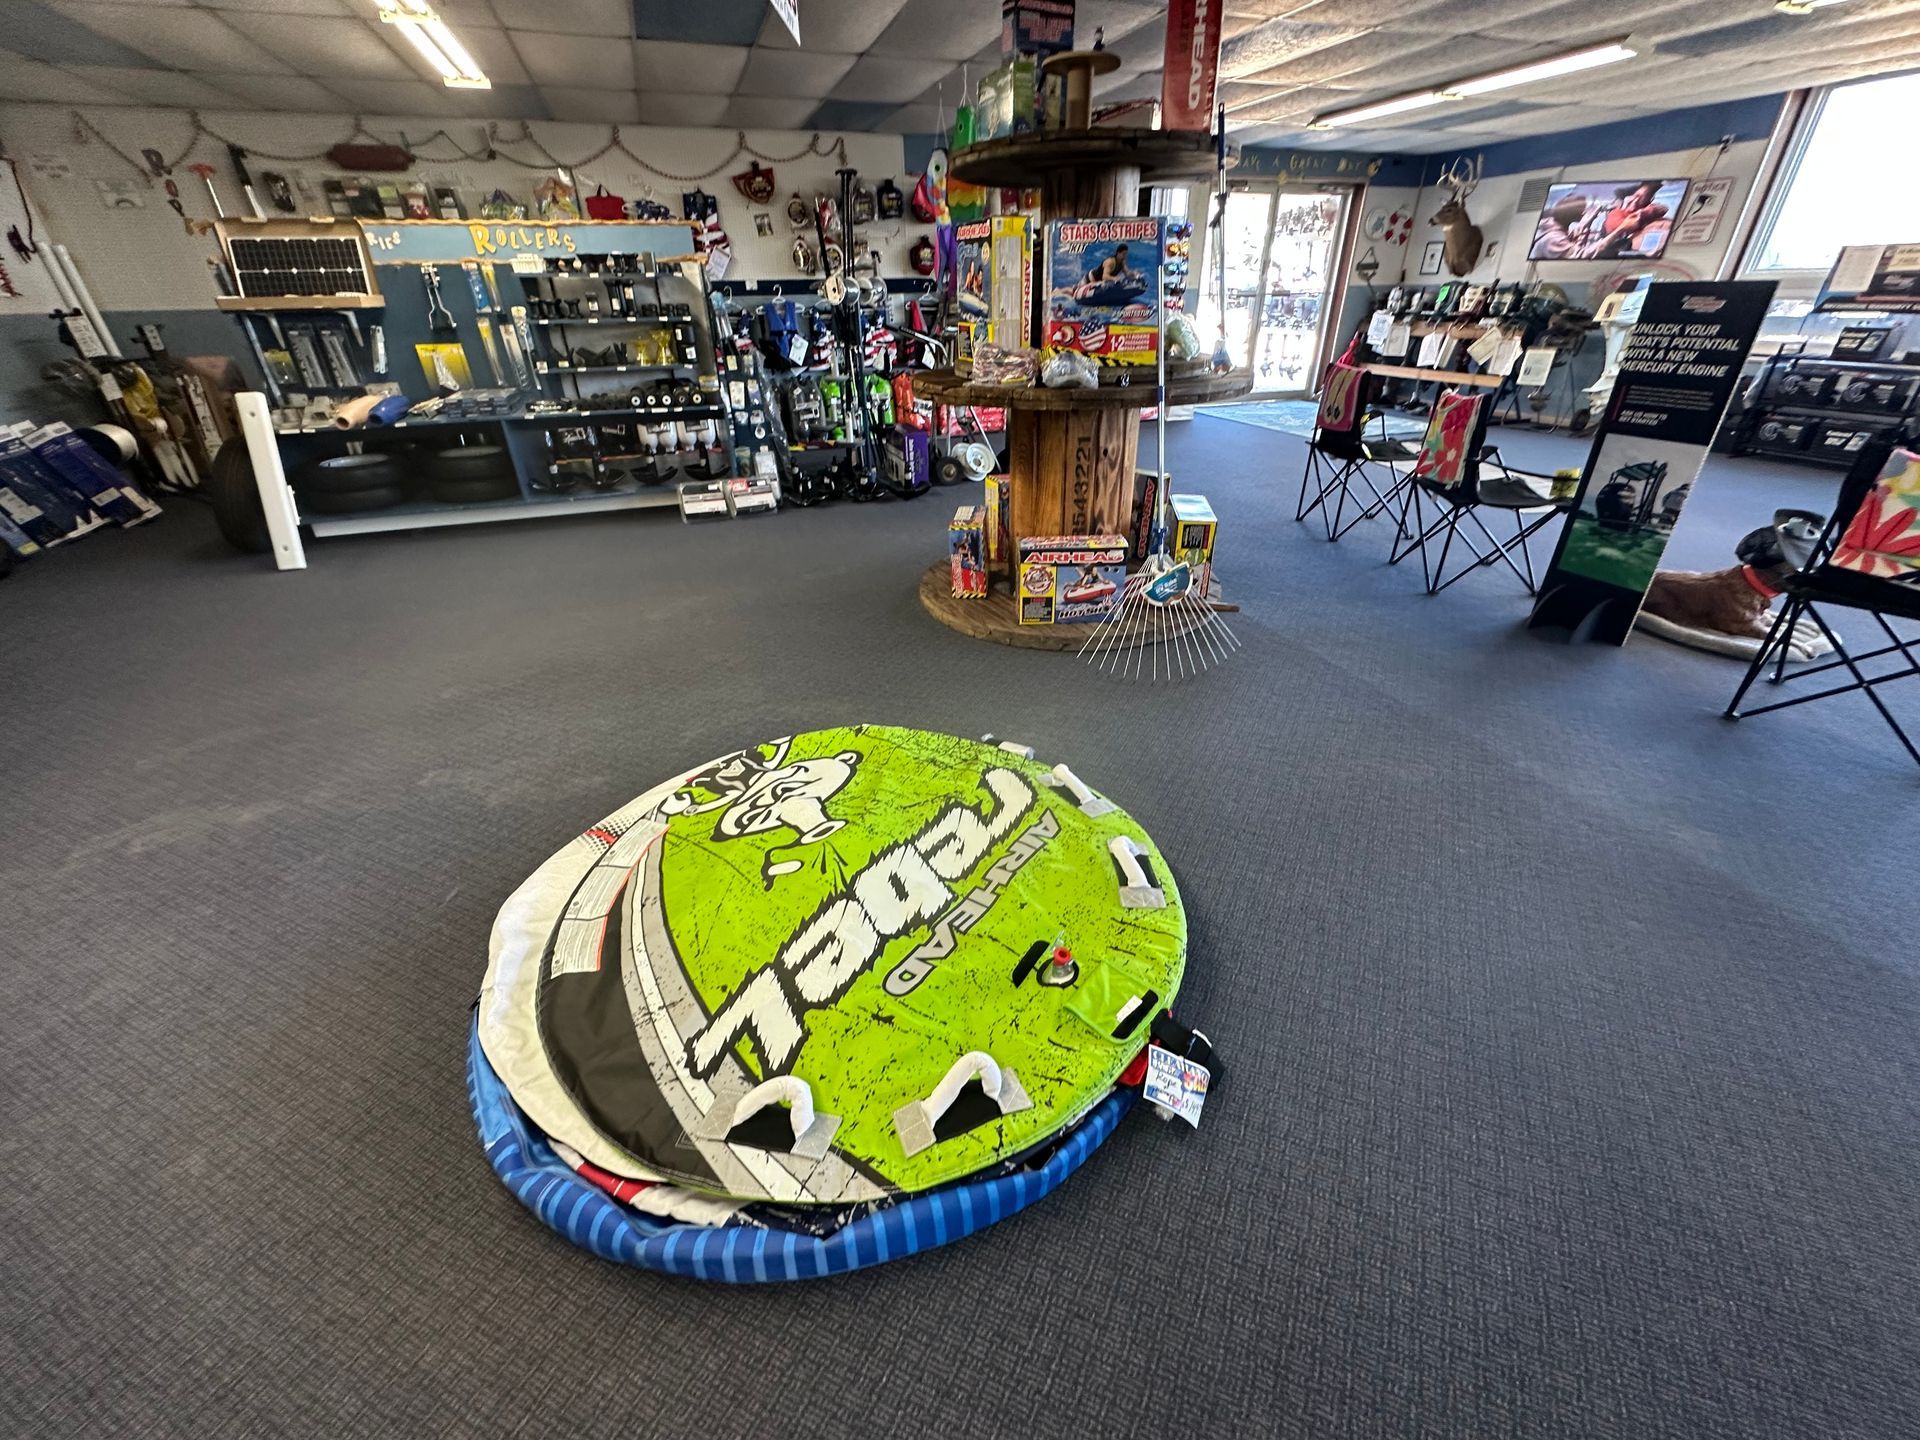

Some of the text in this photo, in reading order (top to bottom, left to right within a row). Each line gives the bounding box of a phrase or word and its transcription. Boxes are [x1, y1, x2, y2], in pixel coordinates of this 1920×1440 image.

[1188, 0, 1207, 110] HEAD
[365, 231, 401, 250] RIES
[469, 224, 576, 254] ROLLERS
[1060, 221, 1158, 242] STARS & STRIPES
[1023, 258, 1032, 342] AIRHEAD
[1631, 322, 1721, 337] UNLOCK YOUR
[1670, 337, 1740, 351] POTENTIAL
[1623, 348, 1699, 363] WITH A NEW
[1618, 359, 1730, 378] MERCURY ENGINE
[1024, 551, 1125, 564] AIRHEAD
[883, 808, 1062, 996] AIRHEAD
